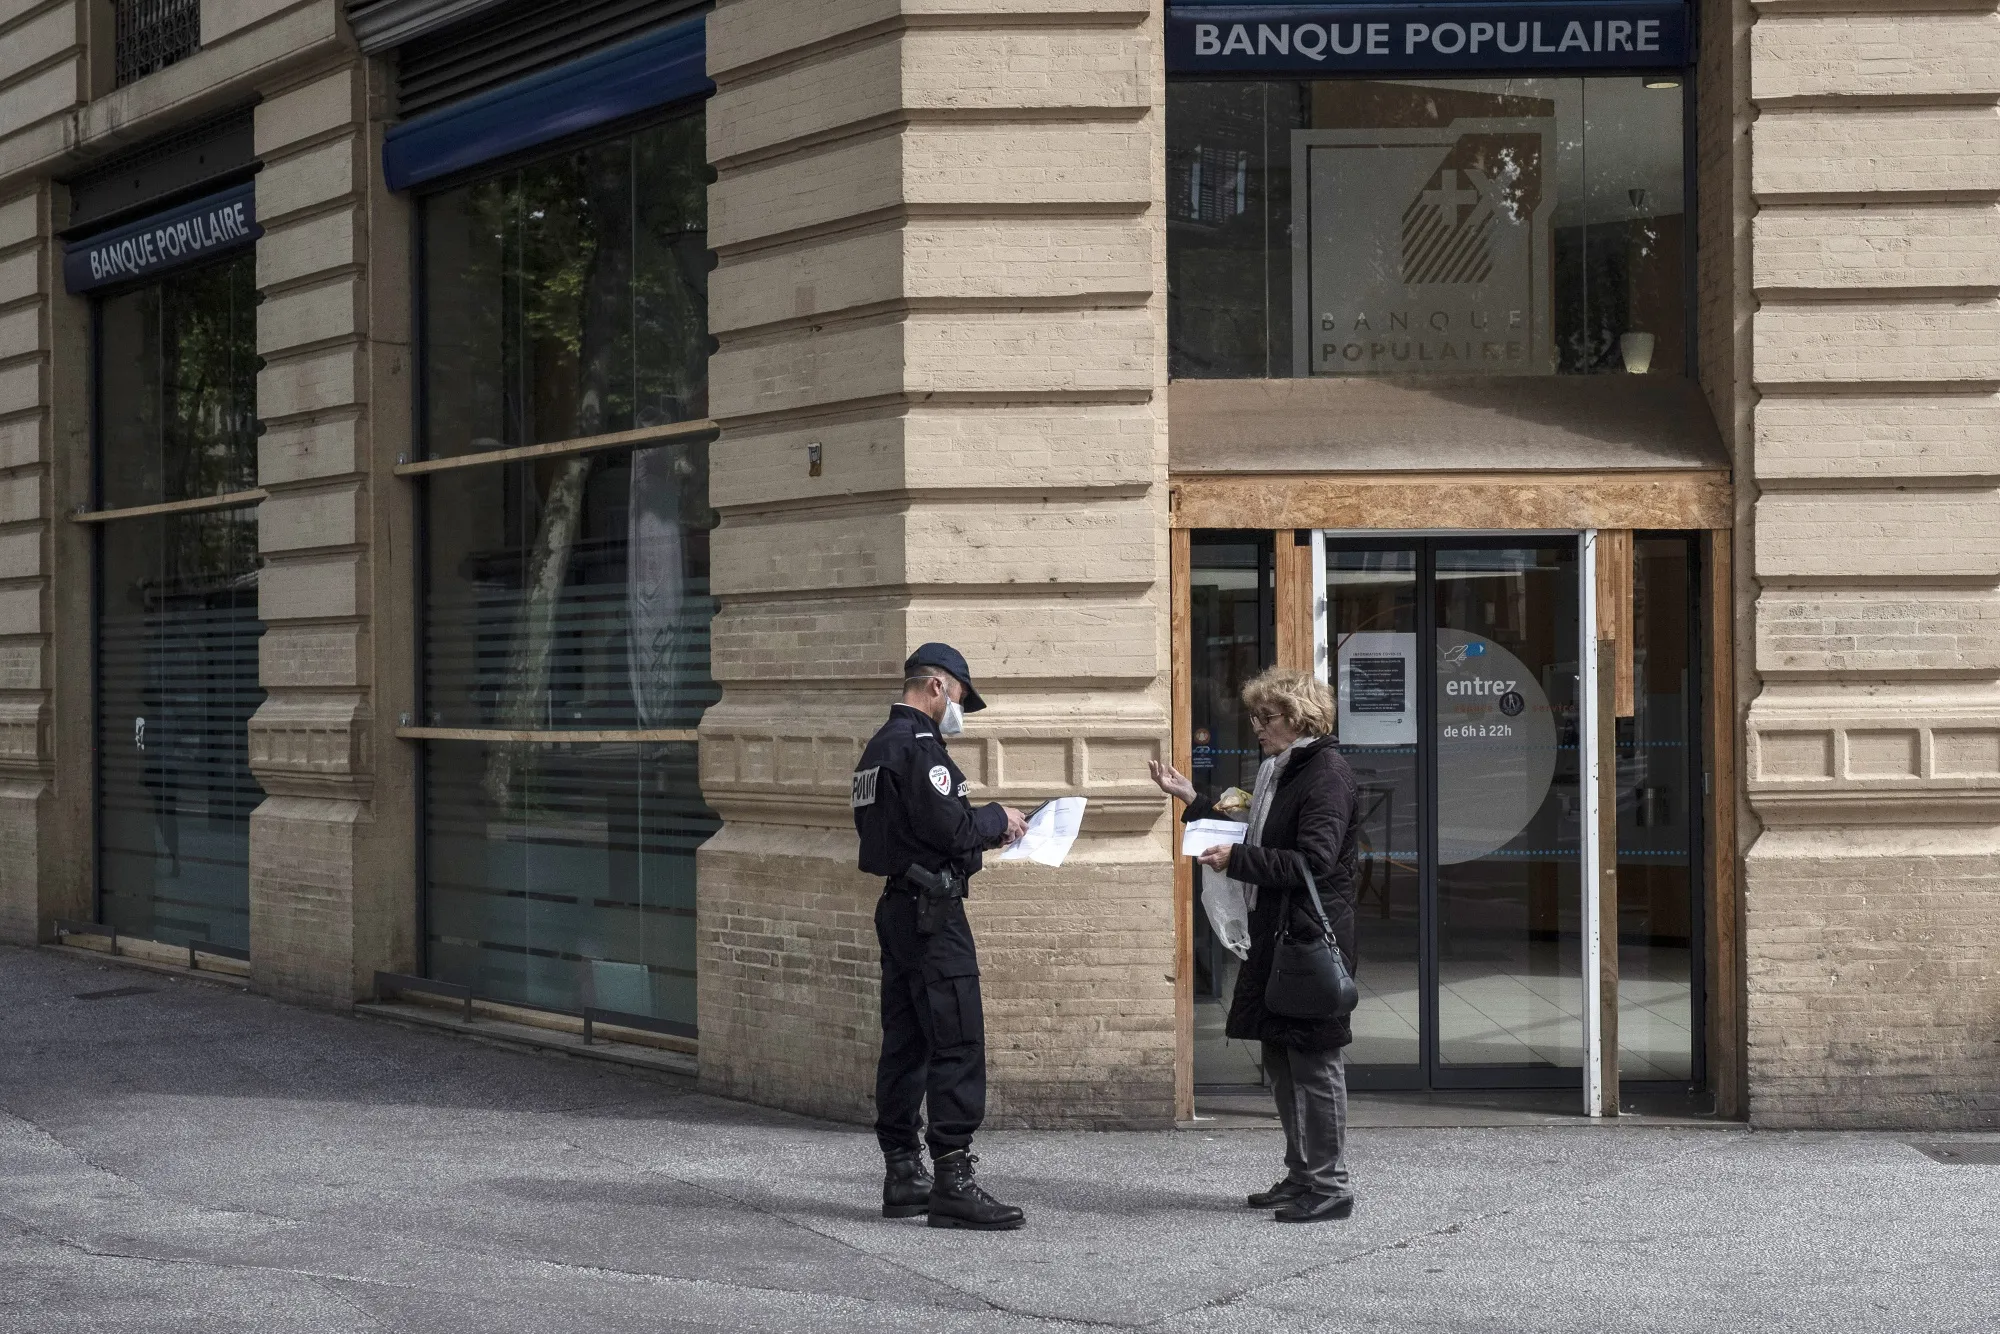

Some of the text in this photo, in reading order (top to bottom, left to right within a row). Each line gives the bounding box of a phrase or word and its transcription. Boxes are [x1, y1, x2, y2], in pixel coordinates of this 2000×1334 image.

[1195, 20, 1660, 61] BANQUE POPULAIRE
[90, 202, 249, 280] BANQUE POPULAIRE
[1321, 310, 1521, 333] BANQUE
[1322, 341, 1521, 362] POPULAIRE
[1446, 676, 1516, 696] entrez
[1443, 725, 1512, 738] de 6h à 22h
